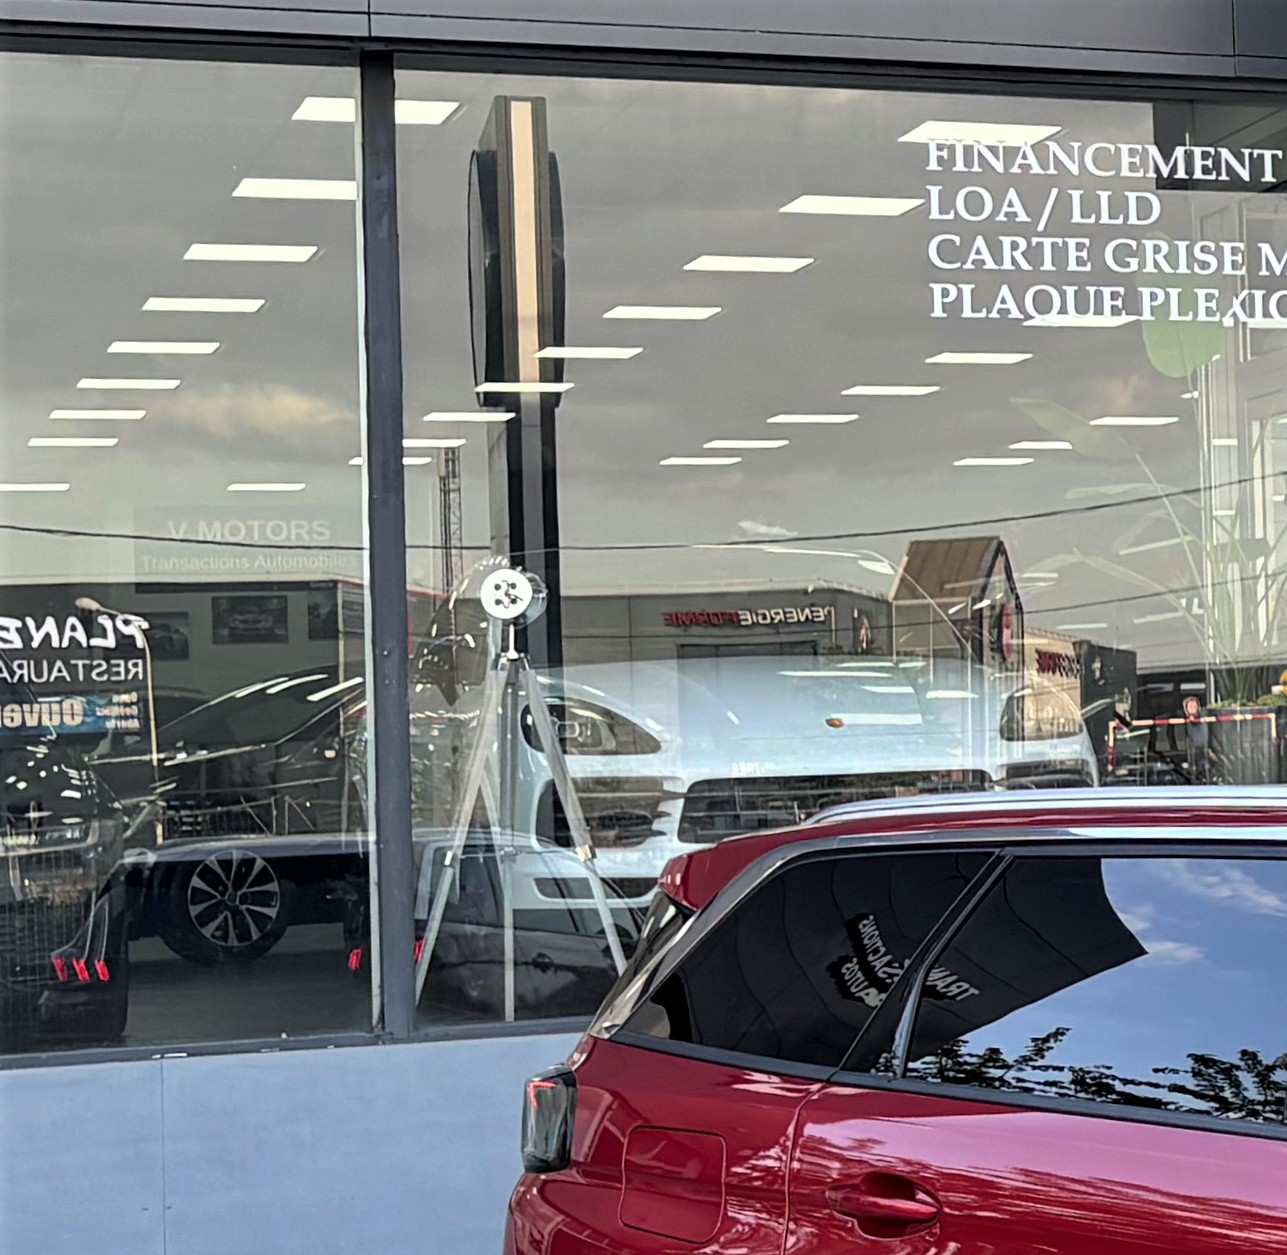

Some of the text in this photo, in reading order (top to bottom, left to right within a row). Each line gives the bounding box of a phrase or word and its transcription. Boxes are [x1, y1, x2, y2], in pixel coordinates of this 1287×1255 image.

[924, 140, 1284, 183] FINANCEMENT
[926, 234, 1092, 272] CARTE
[1103, 237, 1246, 276] GRISE
[928, 283, 1128, 324] PLAQUE
[198, 520, 331, 542] MOTORS
[142, 555, 250, 571] Transactions
